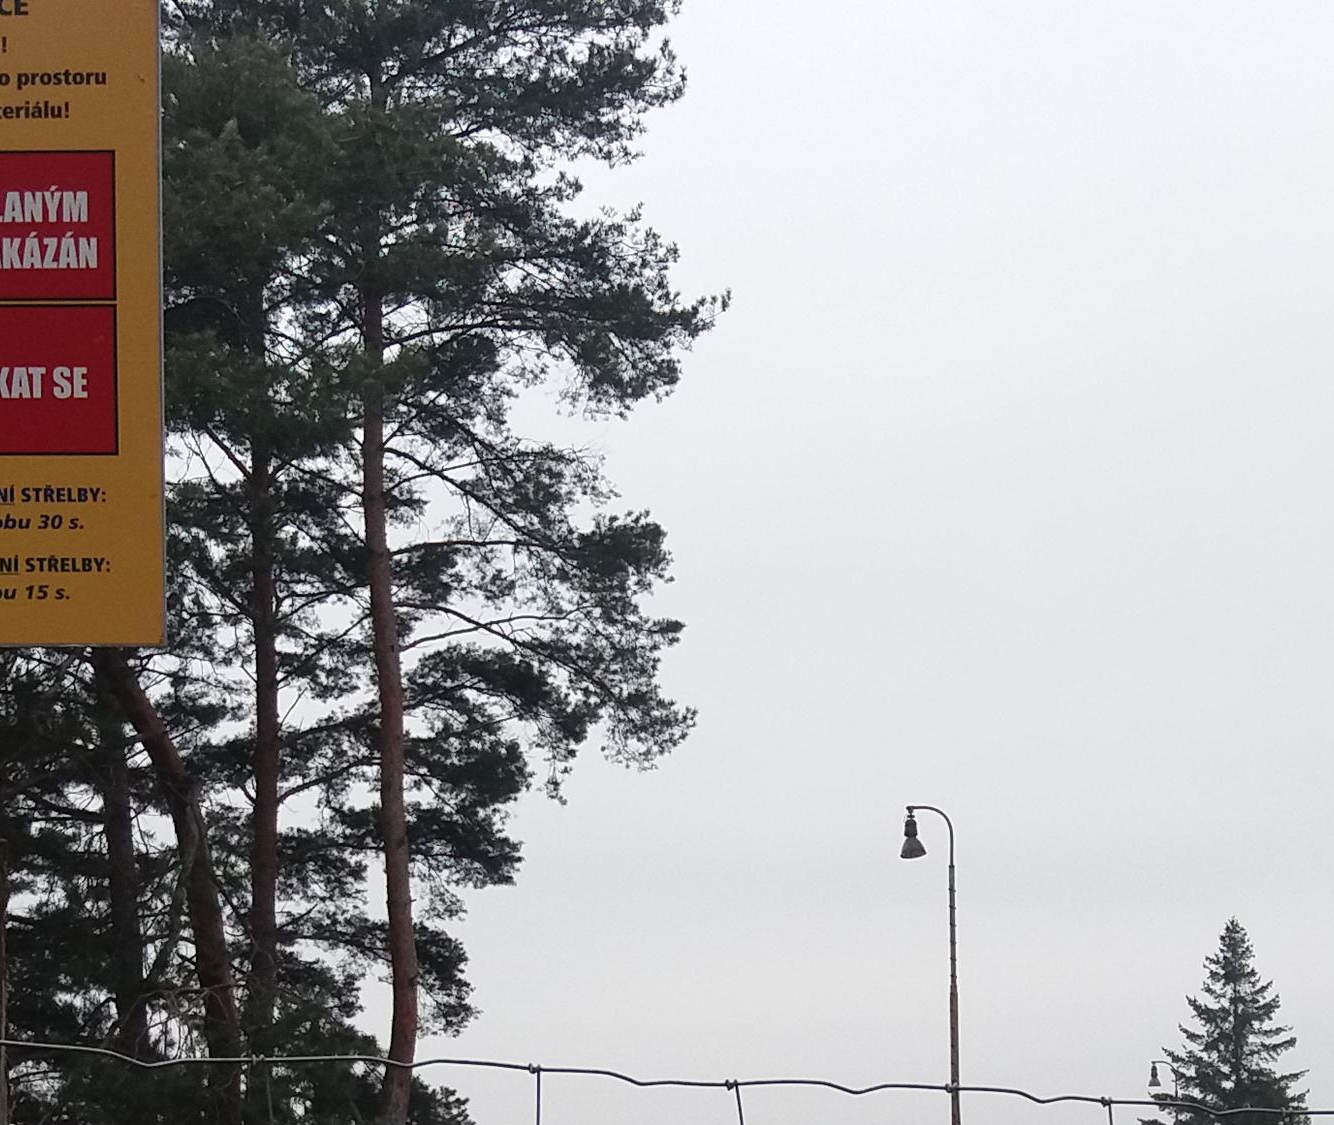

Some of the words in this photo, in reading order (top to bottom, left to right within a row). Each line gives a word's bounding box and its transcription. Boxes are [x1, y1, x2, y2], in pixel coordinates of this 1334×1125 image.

[17, 70, 107, 90] prostoru
[53, 367, 88, 399] SE
[21, 485, 106, 503] STŘELBY:
[37, 515, 63, 530] 30
[69, 518, 84, 530] s.
[25, 555, 111, 573] STŘELBY:
[25, 585, 49, 600] 15
[55, 588, 70, 600] s.
